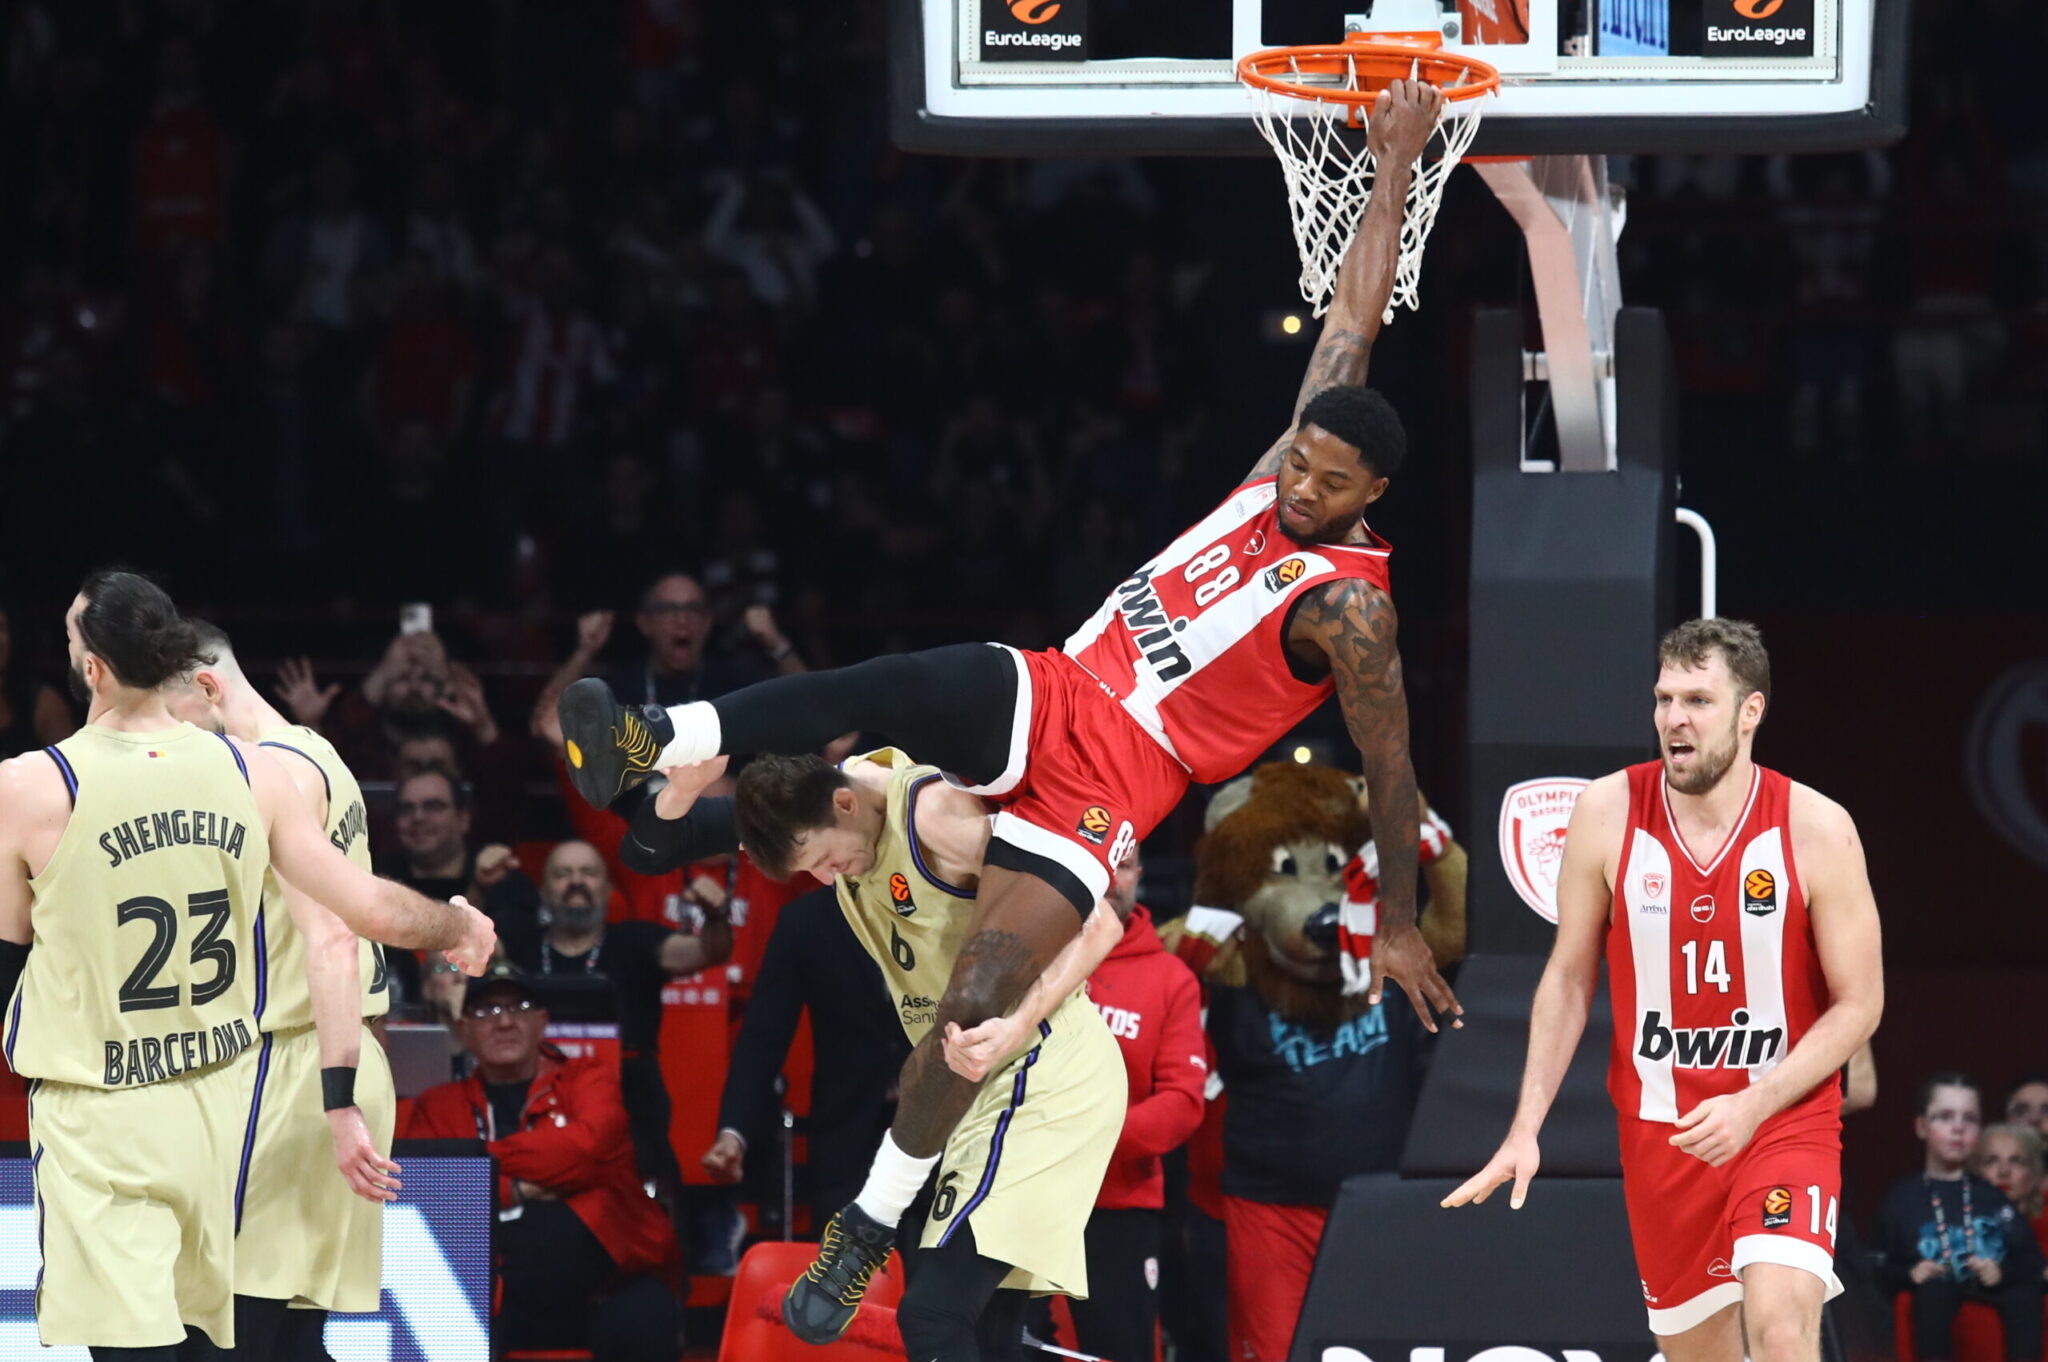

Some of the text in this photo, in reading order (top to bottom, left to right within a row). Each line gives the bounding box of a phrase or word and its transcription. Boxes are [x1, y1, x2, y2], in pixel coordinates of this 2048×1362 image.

[985, 31, 1082, 51] EuroLeague
[1707, 26, 1806, 45] EuroLeague
[1184, 544, 1240, 607] 88
[1117, 564, 1192, 683] bwin
[1517, 791, 1581, 808] OLYMPI
[99, 809, 246, 868] SHENGELIA
[117, 888, 236, 1013] 23
[891, 920, 916, 972] 6
[1681, 940, 1732, 995] 14
[902, 1010, 938, 1025] Sani
[1096, 1004, 1142, 1040] COS
[1274, 1003, 1389, 1072] TEAM
[1637, 1010, 1783, 1067] bwin
[103, 1018, 252, 1086] BARCELONA
[932, 1170, 959, 1222] 6
[1806, 1184, 1837, 1249] 14
